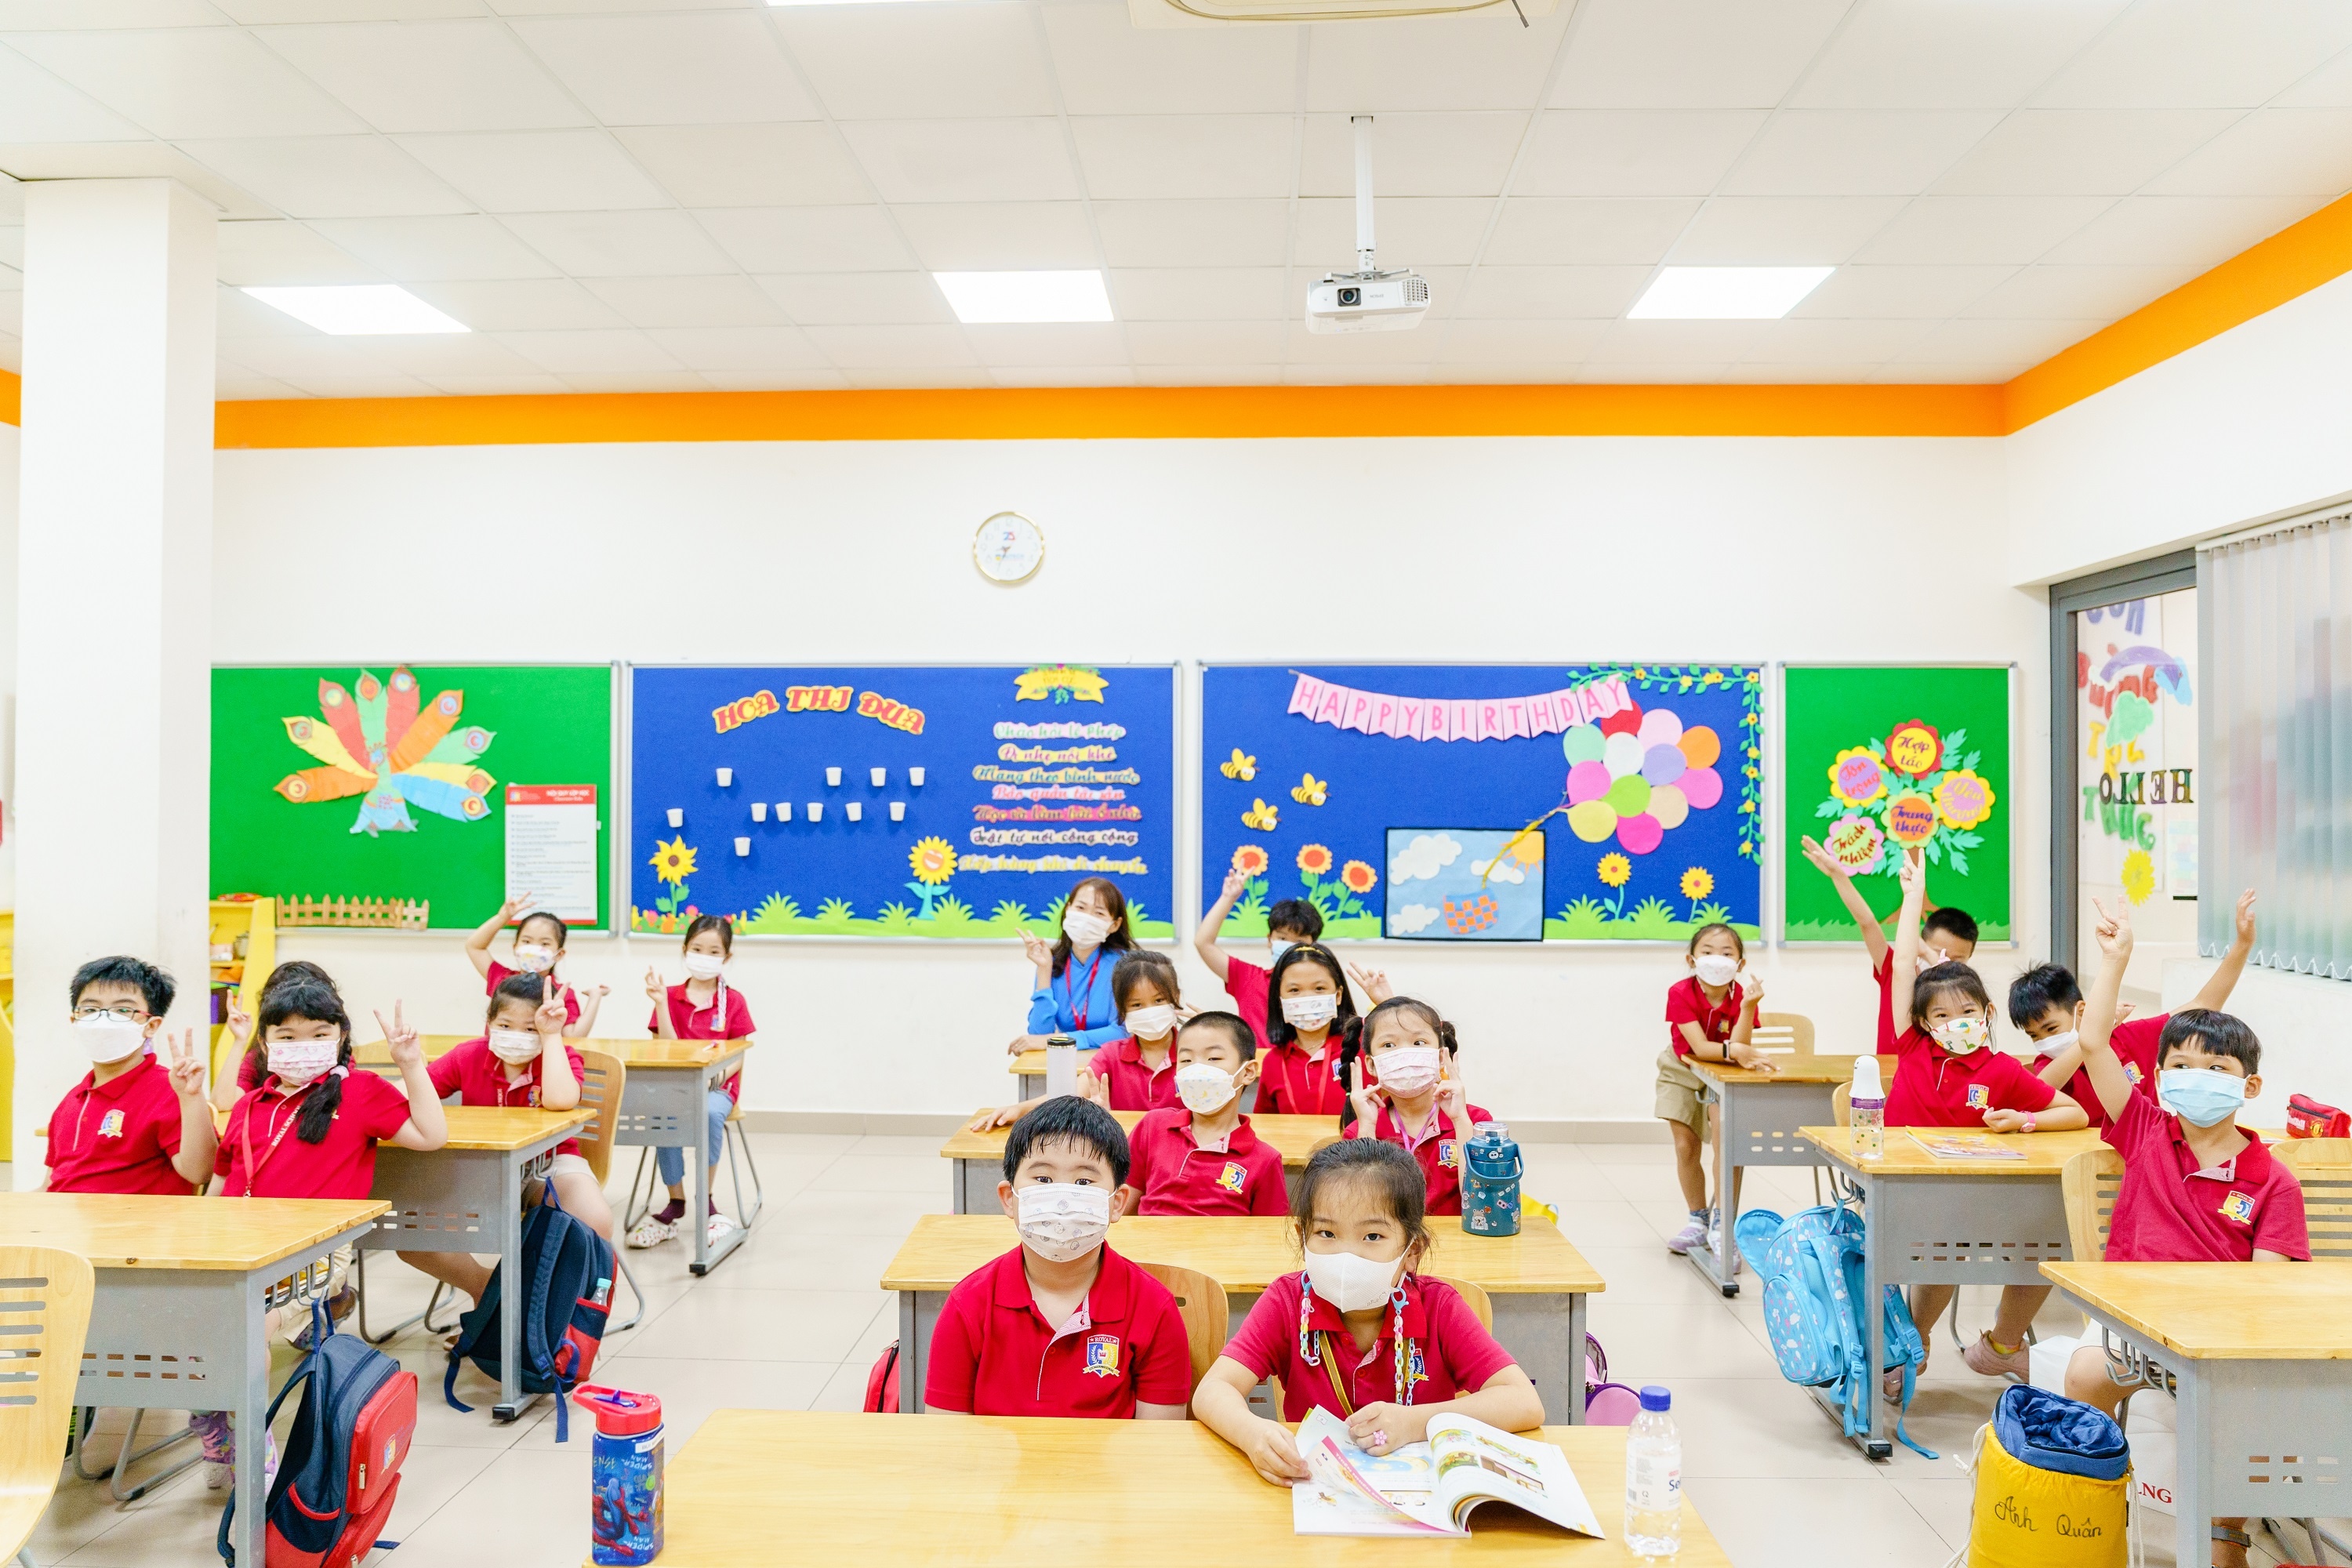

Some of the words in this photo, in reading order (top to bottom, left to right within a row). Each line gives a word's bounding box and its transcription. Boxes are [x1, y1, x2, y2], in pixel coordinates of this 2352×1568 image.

[714, 692, 778, 731] HOA
[1898, 736, 1929, 753] Hợp
[1840, 761, 1867, 782] Tôn
[1900, 755, 1922, 768] tác
[974, 766, 1024, 782] Mang
[1029, 768, 1058, 782] theo
[1845, 771, 1881, 797] trọng
[1951, 779, 1983, 800] Yêu
[1892, 806, 1933, 823] Trung
[1062, 829, 1095, 844] công
[1102, 829, 1136, 844] cộng
[1831, 824, 1867, 854] Trách
[1896, 821, 1928, 836] thực
[1839, 837, 1877, 864] nhiệm
[630, 1454, 648, 1463] MAN
[2137, 1482, 2172, 1504] NG
[1994, 1496, 2038, 1532] Anh
[2056, 1514, 2103, 1538] Quân
